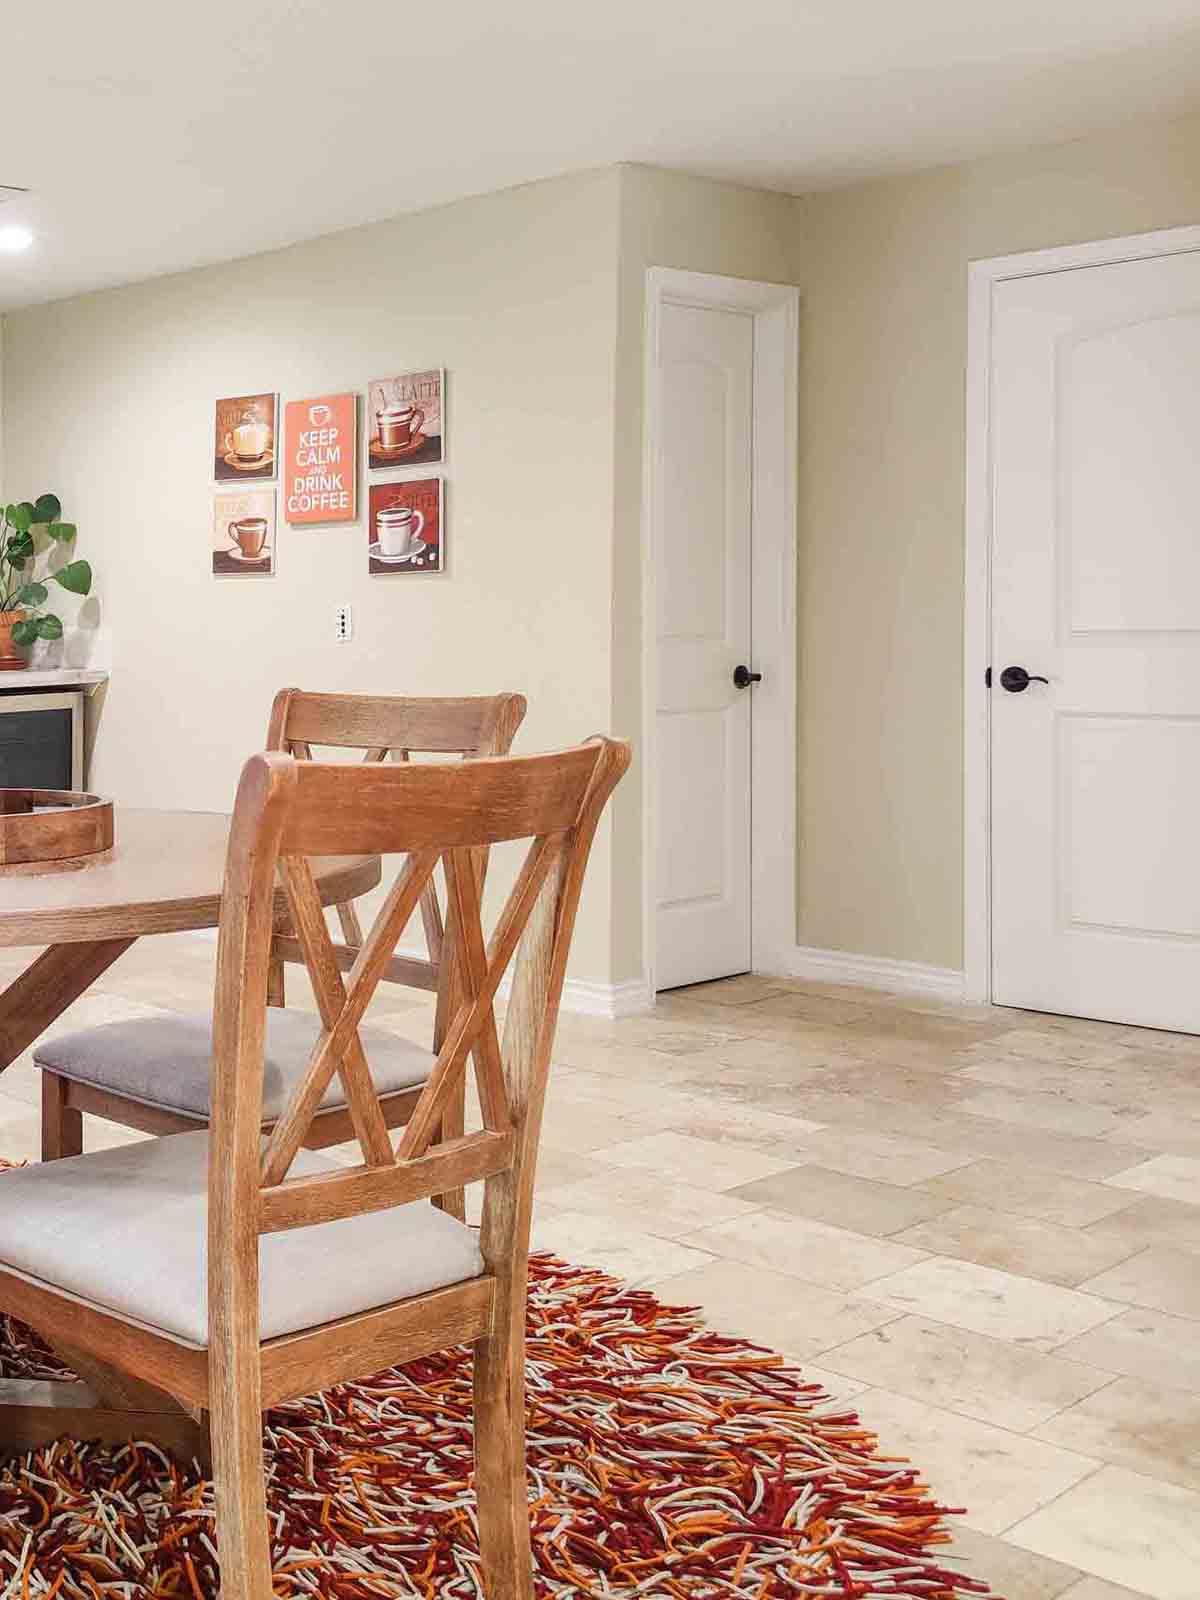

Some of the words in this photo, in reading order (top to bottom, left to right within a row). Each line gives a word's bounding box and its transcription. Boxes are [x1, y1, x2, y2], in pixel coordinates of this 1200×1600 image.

[299, 428, 338, 448] KEEP
[296, 447, 340, 467] CALM
[294, 474, 343, 495] DRINK
[288, 491, 348, 512] COFFEE
